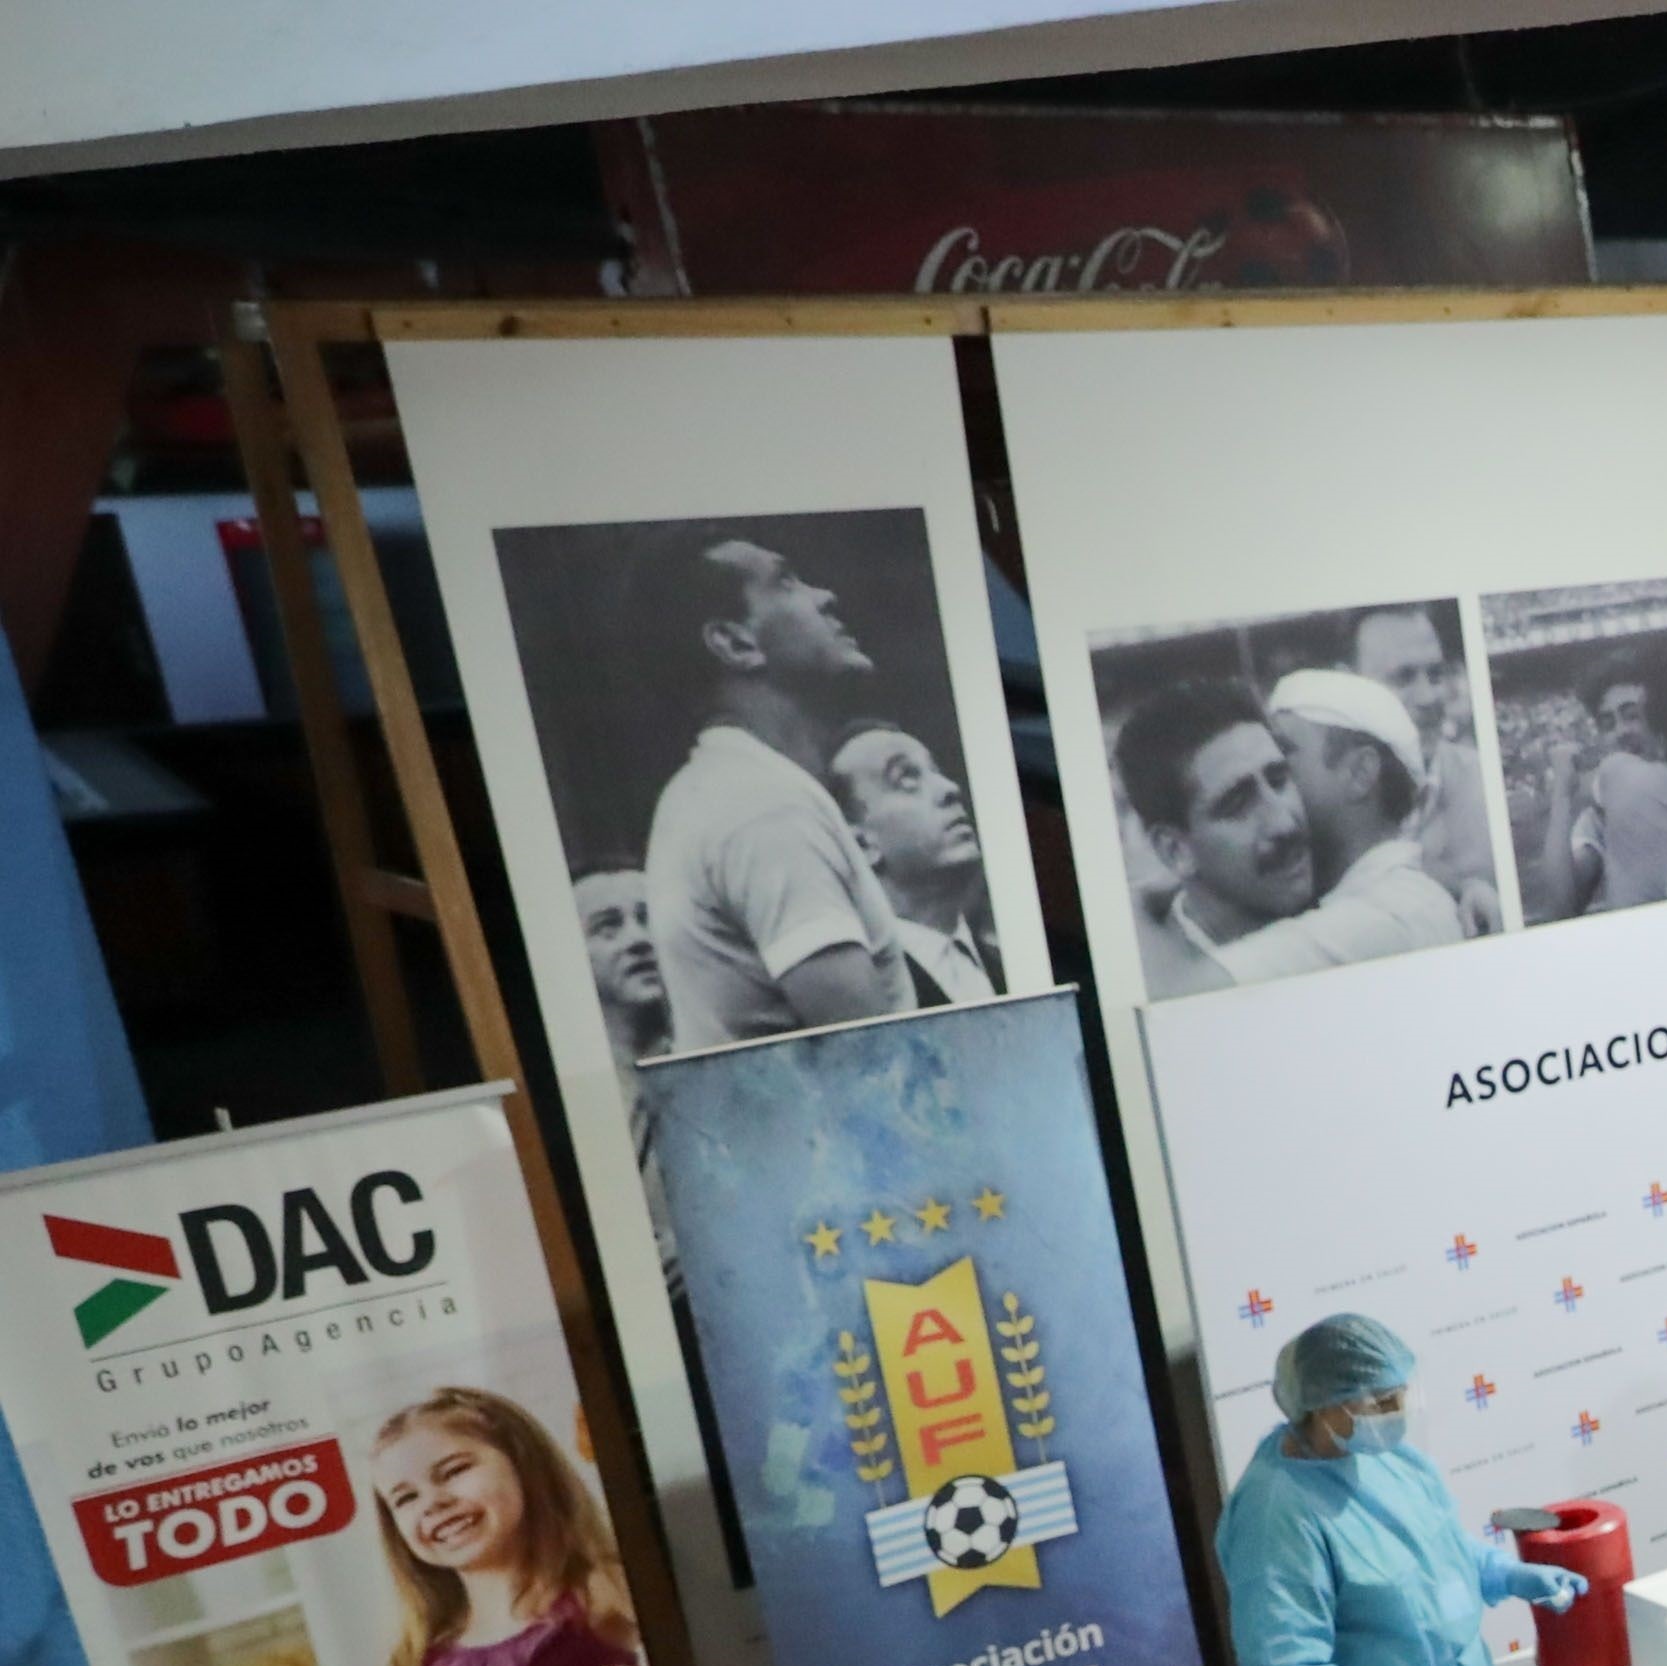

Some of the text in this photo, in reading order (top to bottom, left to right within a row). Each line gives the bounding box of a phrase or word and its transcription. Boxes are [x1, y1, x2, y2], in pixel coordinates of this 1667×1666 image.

[178, 1169, 436, 1317] DAC
[96, 1296, 458, 1393] GrupoAgencia
[902, 1308, 987, 1468] AUF
[88, 1417, 310, 1480] de vos que nosotros
[176, 1416, 199, 1433] lo
[206, 1400, 271, 1426] mejor
[104, 1454, 319, 1524] LO ENTREGAMOS
[113, 1479, 328, 1572] TODO
